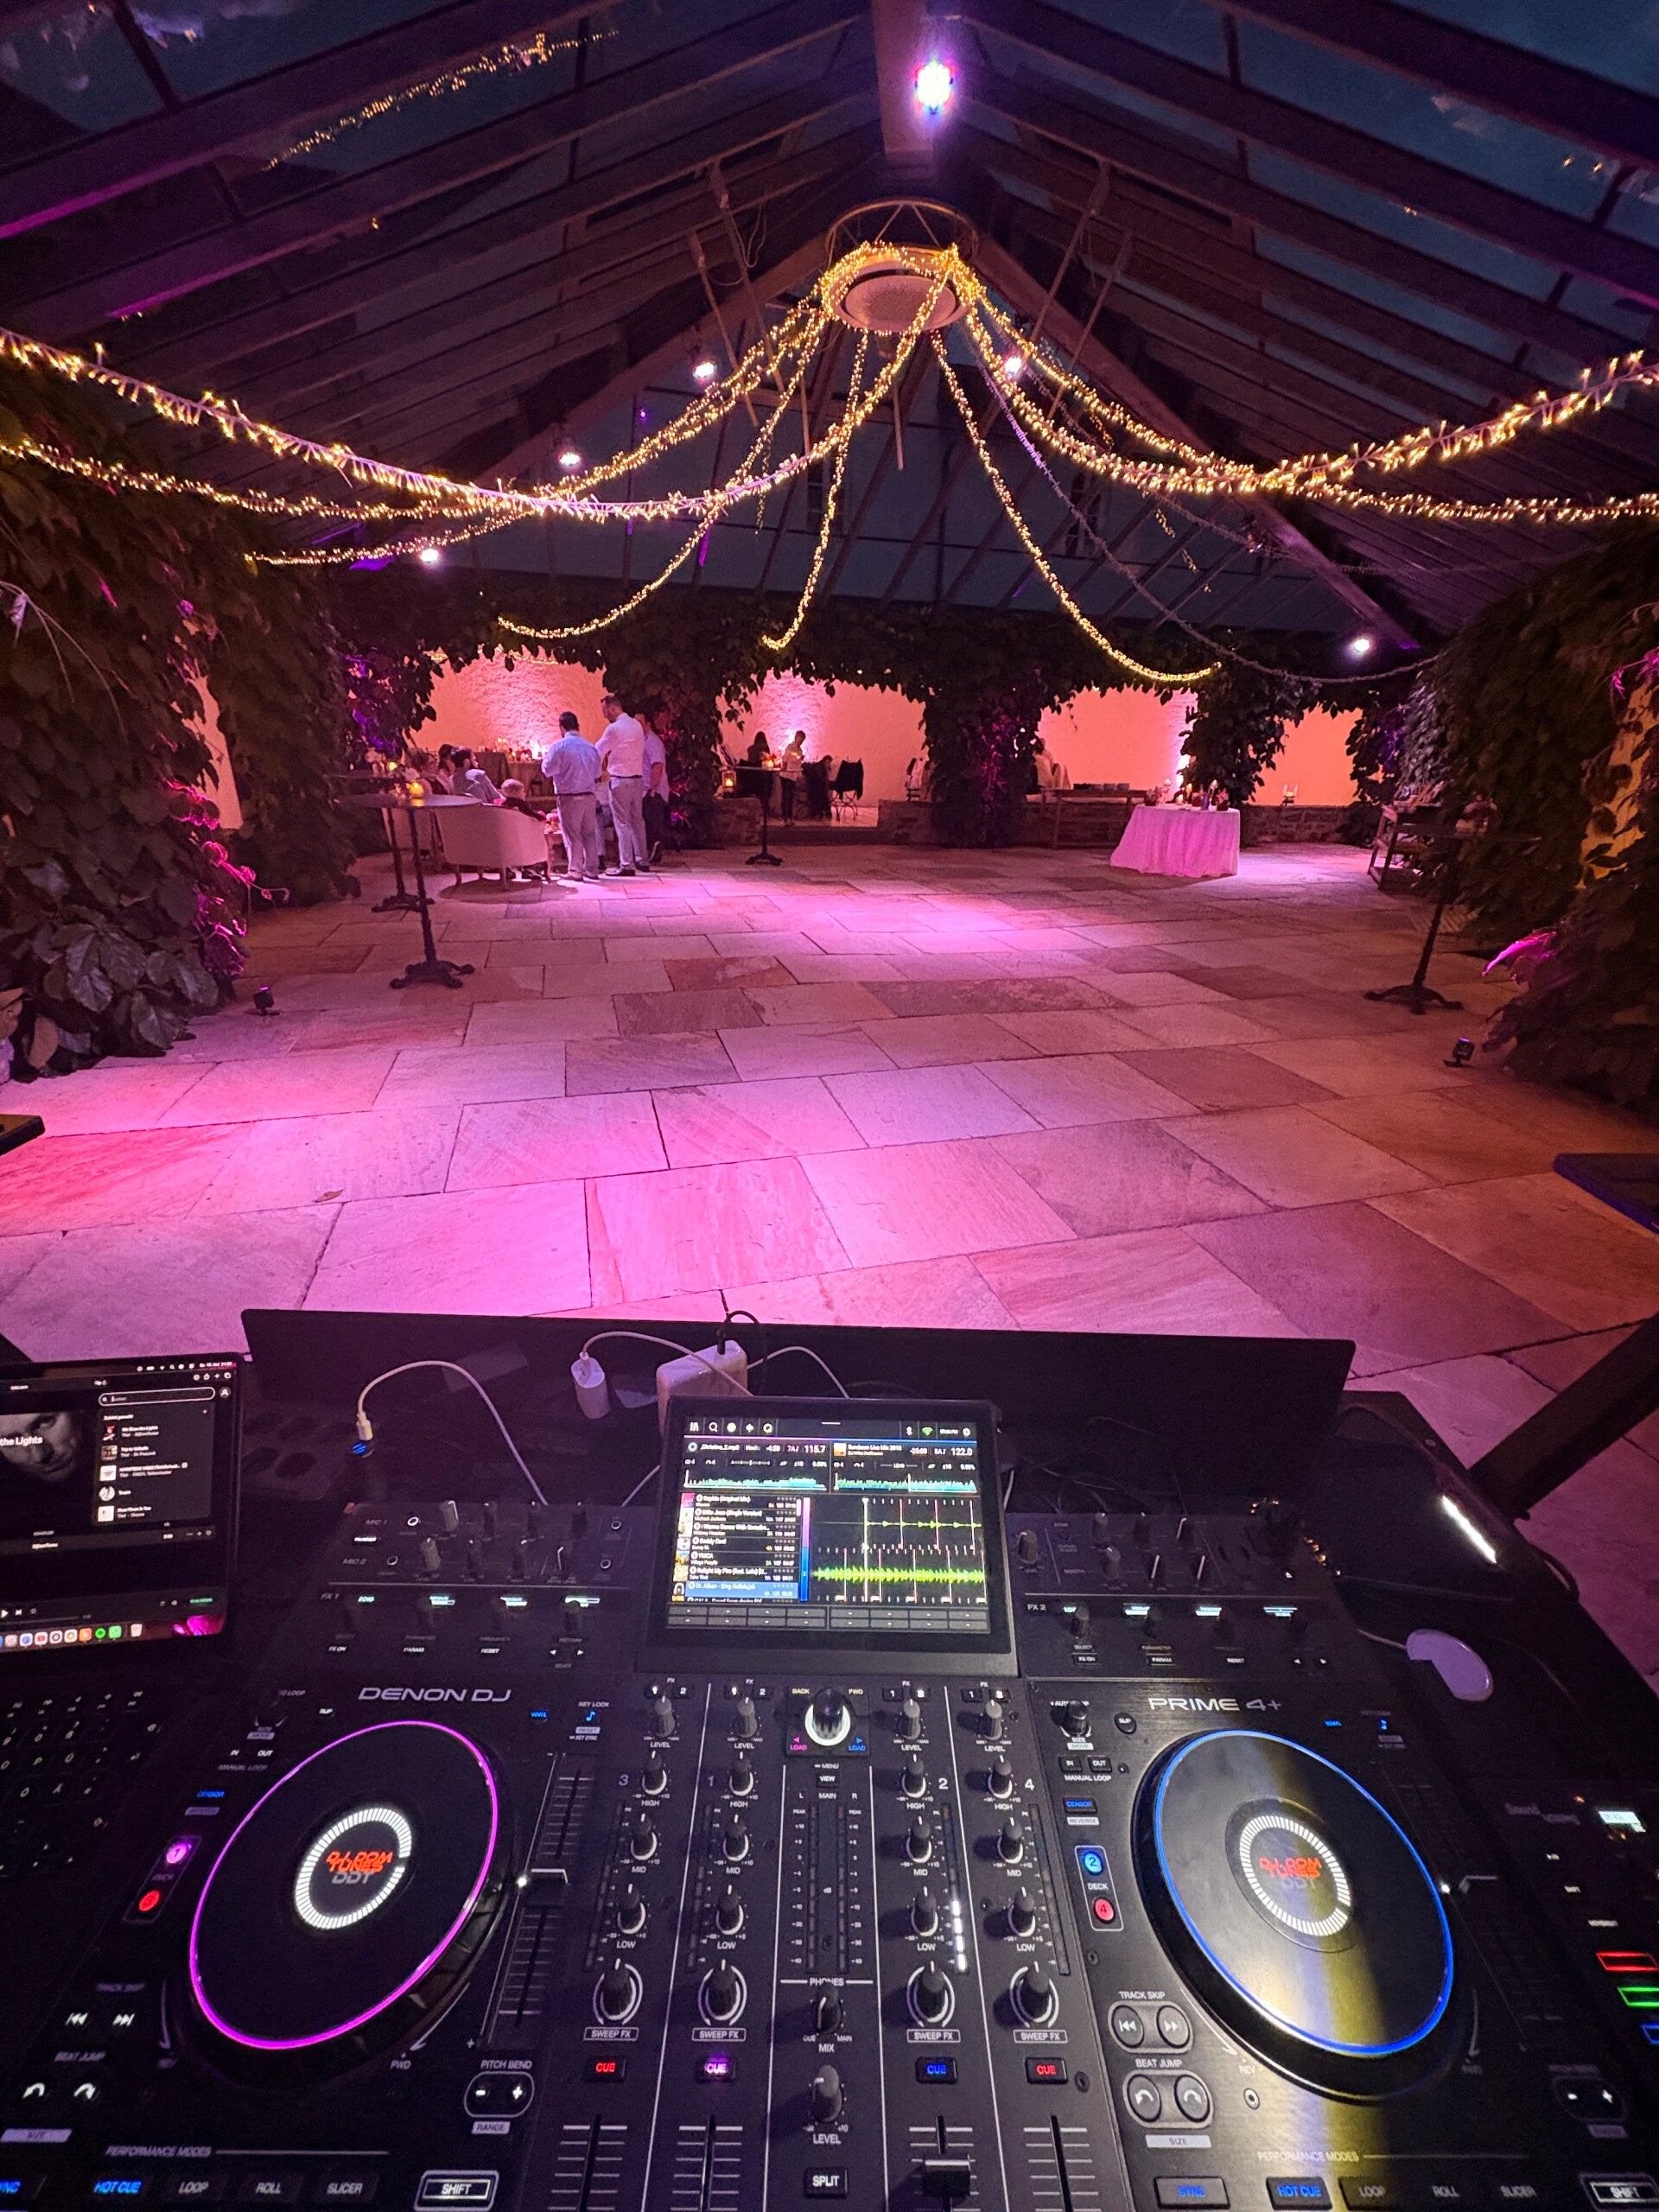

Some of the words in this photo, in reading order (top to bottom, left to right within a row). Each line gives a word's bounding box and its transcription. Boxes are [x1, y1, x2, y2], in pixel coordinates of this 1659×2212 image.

[0, 1437, 15, 1446] the
[16, 1435, 43, 1446] Lights
[804, 1445, 826, 1454] 115.7
[950, 1447, 973, 1457] 122.0
[358, 1687, 467, 1701] DENON
[471, 1688, 512, 1702] DJ
[760, 1688, 766, 1696] 2
[1148, 1697, 1240, 1711] PRIME
[1246, 1699, 1283, 1711] 4+
[619, 1774, 629, 1787] 3
[708, 1776, 715, 1787] 1
[938, 1777, 949, 1789] 2
[1025, 1778, 1035, 1790] 4
[1066, 1800, 1093, 1808] CENSOR
[332, 1872, 376, 1884] DDT
[616, 1941, 636, 1949] LOW
[1016, 1943, 1035, 1952] LOW
[1118, 1991, 1147, 1999] TRACK
[1147, 1991, 1166, 1999] SKIP
[590, 2029, 620, 2038] SWEEP
[620, 2030, 632, 2038] FX
[699, 2031, 728, 2039] SWEEP
[728, 2031, 740, 2039] FX
[943, 2032, 954, 2041] FX
[818, 2044, 835, 2053] MIX
[391, 2060, 411, 2069] FWD
[480, 2059, 506, 2069] PITCH
[506, 2060, 532, 2069] BEND
[595, 2063, 616, 2073] CUE
[706, 2063, 728, 2074] CUE
[926, 2064, 947, 2074] CUE
[1135, 2059, 1158, 2068] BEAT
[1159, 2059, 1183, 2068] JUMP
[1036, 2065, 1057, 2075] CUE
[1239, 2065, 1255, 2075] REV
[476, 2123, 505, 2133] RANGE
[813, 2133, 842, 2145] LEVEL
[1169, 2137, 1187, 2145] SIZE
[105, 2145, 175, 2158] PERFORMANCE
[175, 2146, 213, 2158] MODES
[1257, 2151, 1325, 2162] PERFORMANCE
[1325, 2152, 1360, 2162] MODES
[812, 2175, 840, 2187] SPLIT
[93, 2180, 116, 2194] HOT
[117, 2180, 143, 2195] CUE
[178, 2181, 210, 2195] LOOP
[255, 2183, 282, 2194] ROLL
[327, 2183, 364, 2195] SLICER
[442, 2183, 473, 2196] SHIFT
[1277, 2184, 1298, 2197] HOT
[1300, 2184, 1322, 2197] CUE
[1358, 2185, 1386, 2198] LOOP
[1431, 2186, 1460, 2198] ROLL
[1499, 2185, 1538, 2198] SLICER
[1610, 2186, 1640, 2198] SHIFT
